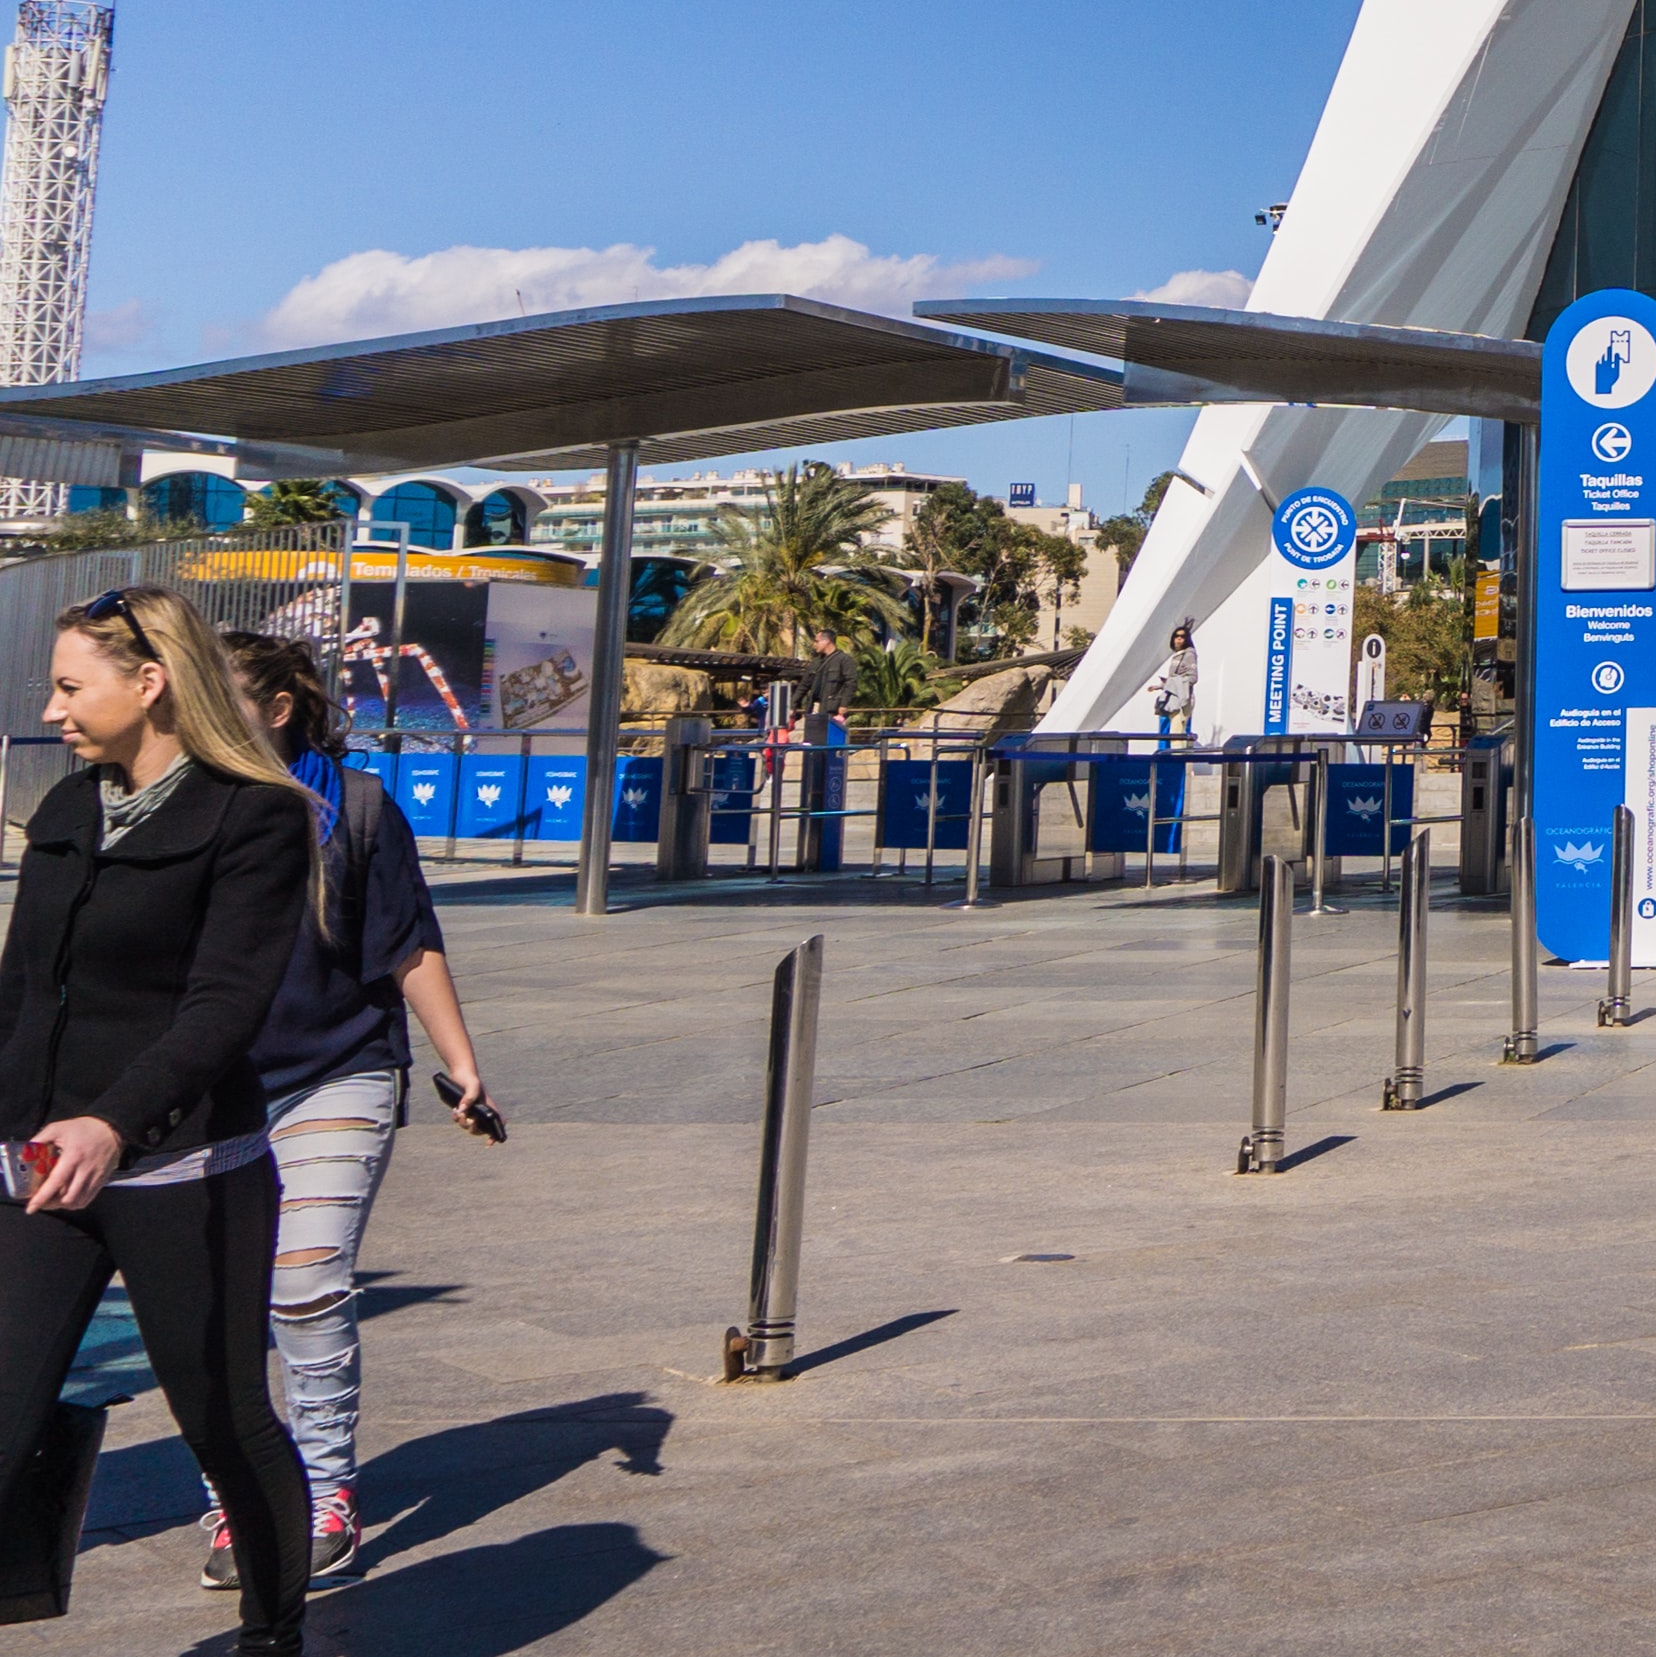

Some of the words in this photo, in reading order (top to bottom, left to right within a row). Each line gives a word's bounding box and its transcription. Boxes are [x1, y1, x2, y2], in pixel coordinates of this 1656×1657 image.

[1579, 473, 1643, 489] Taquillas
[1582, 489, 1611, 499] Ticket
[1612, 489, 1639, 498] Office
[1281, 500, 1301, 523] PUNTO
[1300, 495, 1312, 504] DE
[1312, 495, 1349, 526] ENCUENTRO
[1591, 501, 1631, 512] Taquilles
[1566, 604, 1653, 619] Bienvenidos
[1273, 603, 1288, 651] POINT
[1588, 620, 1631, 630] Welcome
[1583, 632, 1635, 643] Benvinguts
[1269, 654, 1285, 723] MEETING
[1601, 709, 1612, 717] en
[1613, 708, 1622, 717] el
[1549, 718, 1579, 727] Edificio
[1580, 718, 1591, 727] de
[1592, 718, 1621, 727] Acceso
